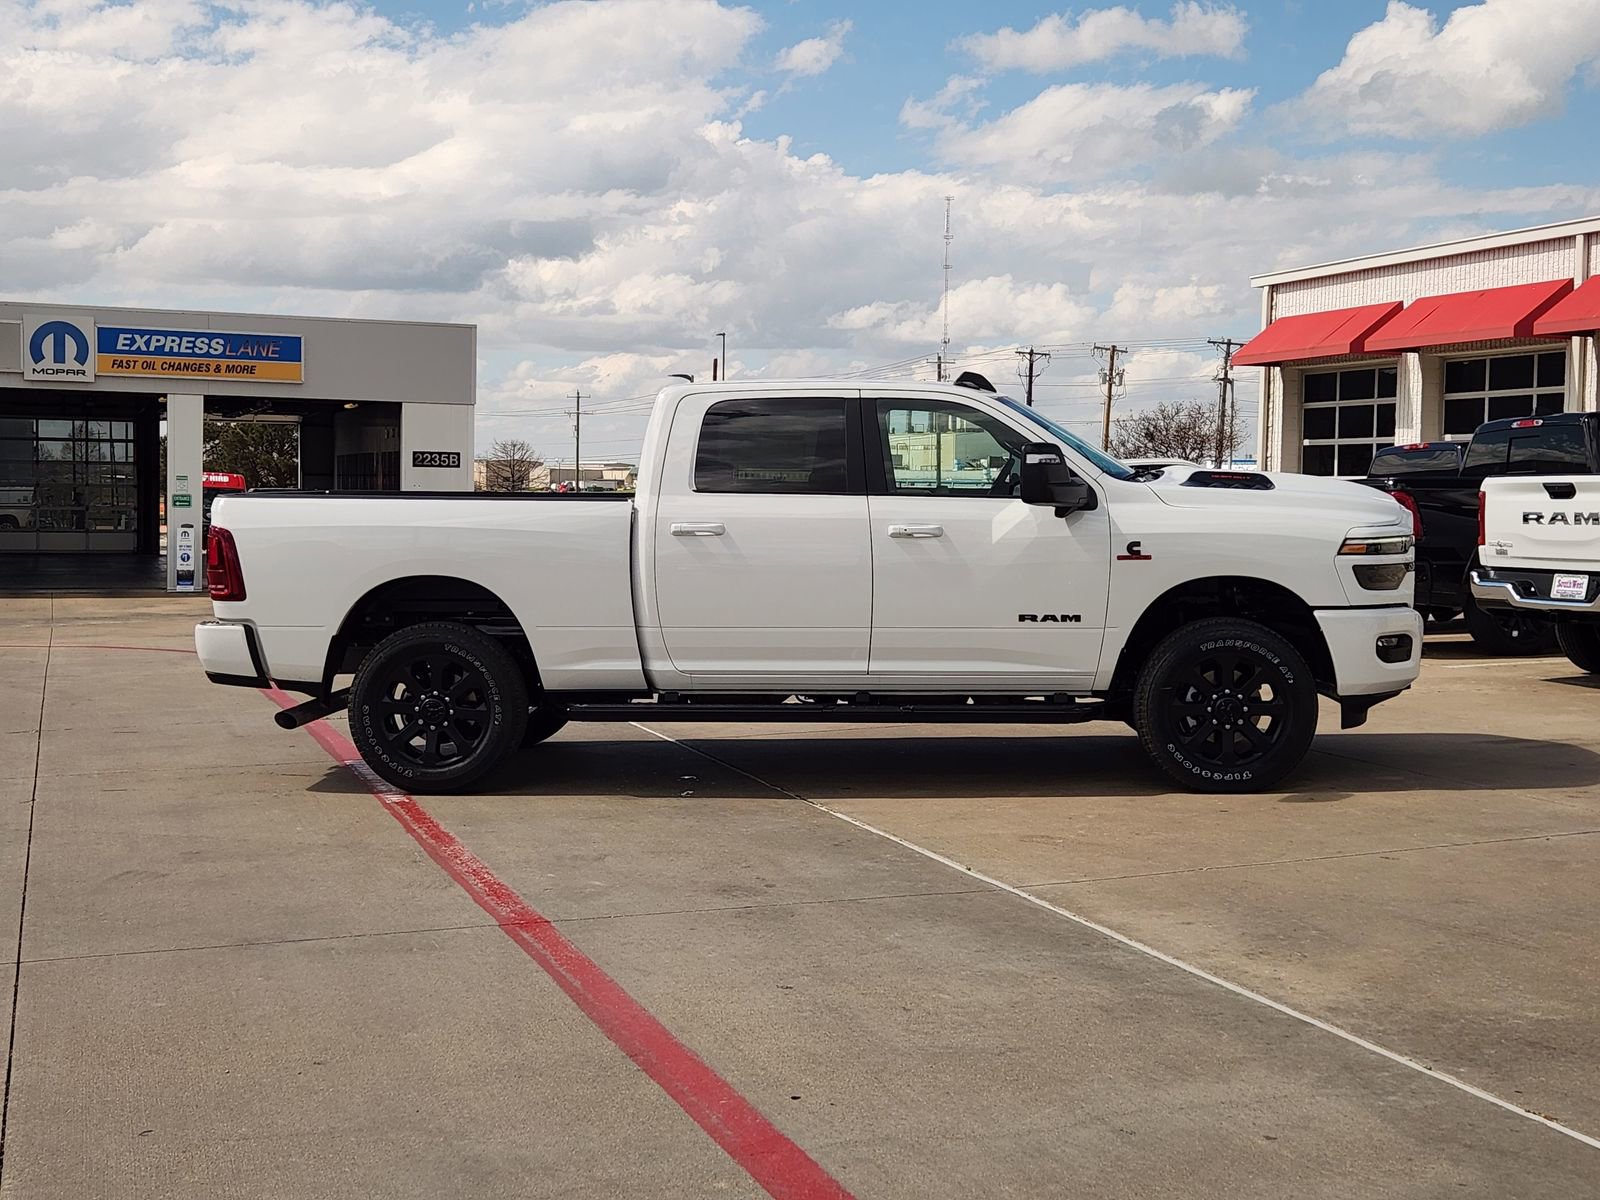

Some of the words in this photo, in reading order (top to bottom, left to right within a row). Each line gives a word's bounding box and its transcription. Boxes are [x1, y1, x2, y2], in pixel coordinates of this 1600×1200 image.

[116, 333, 225, 356] EXPRESS
[226, 339, 282, 359] LANE
[32, 367, 88, 377] MOPAR
[111, 359, 138, 371] FAST
[141, 360, 157, 371] OIL
[160, 361, 211, 374] CHANGES
[213, 363, 222, 374] &
[224, 364, 257, 375] MORE
[414, 452, 459, 467] 2235B
[1522, 511, 1600, 526] RAM
[1018, 613, 1082, 623] RAM
[1199, 638, 1281, 664] TRANSFORCE
